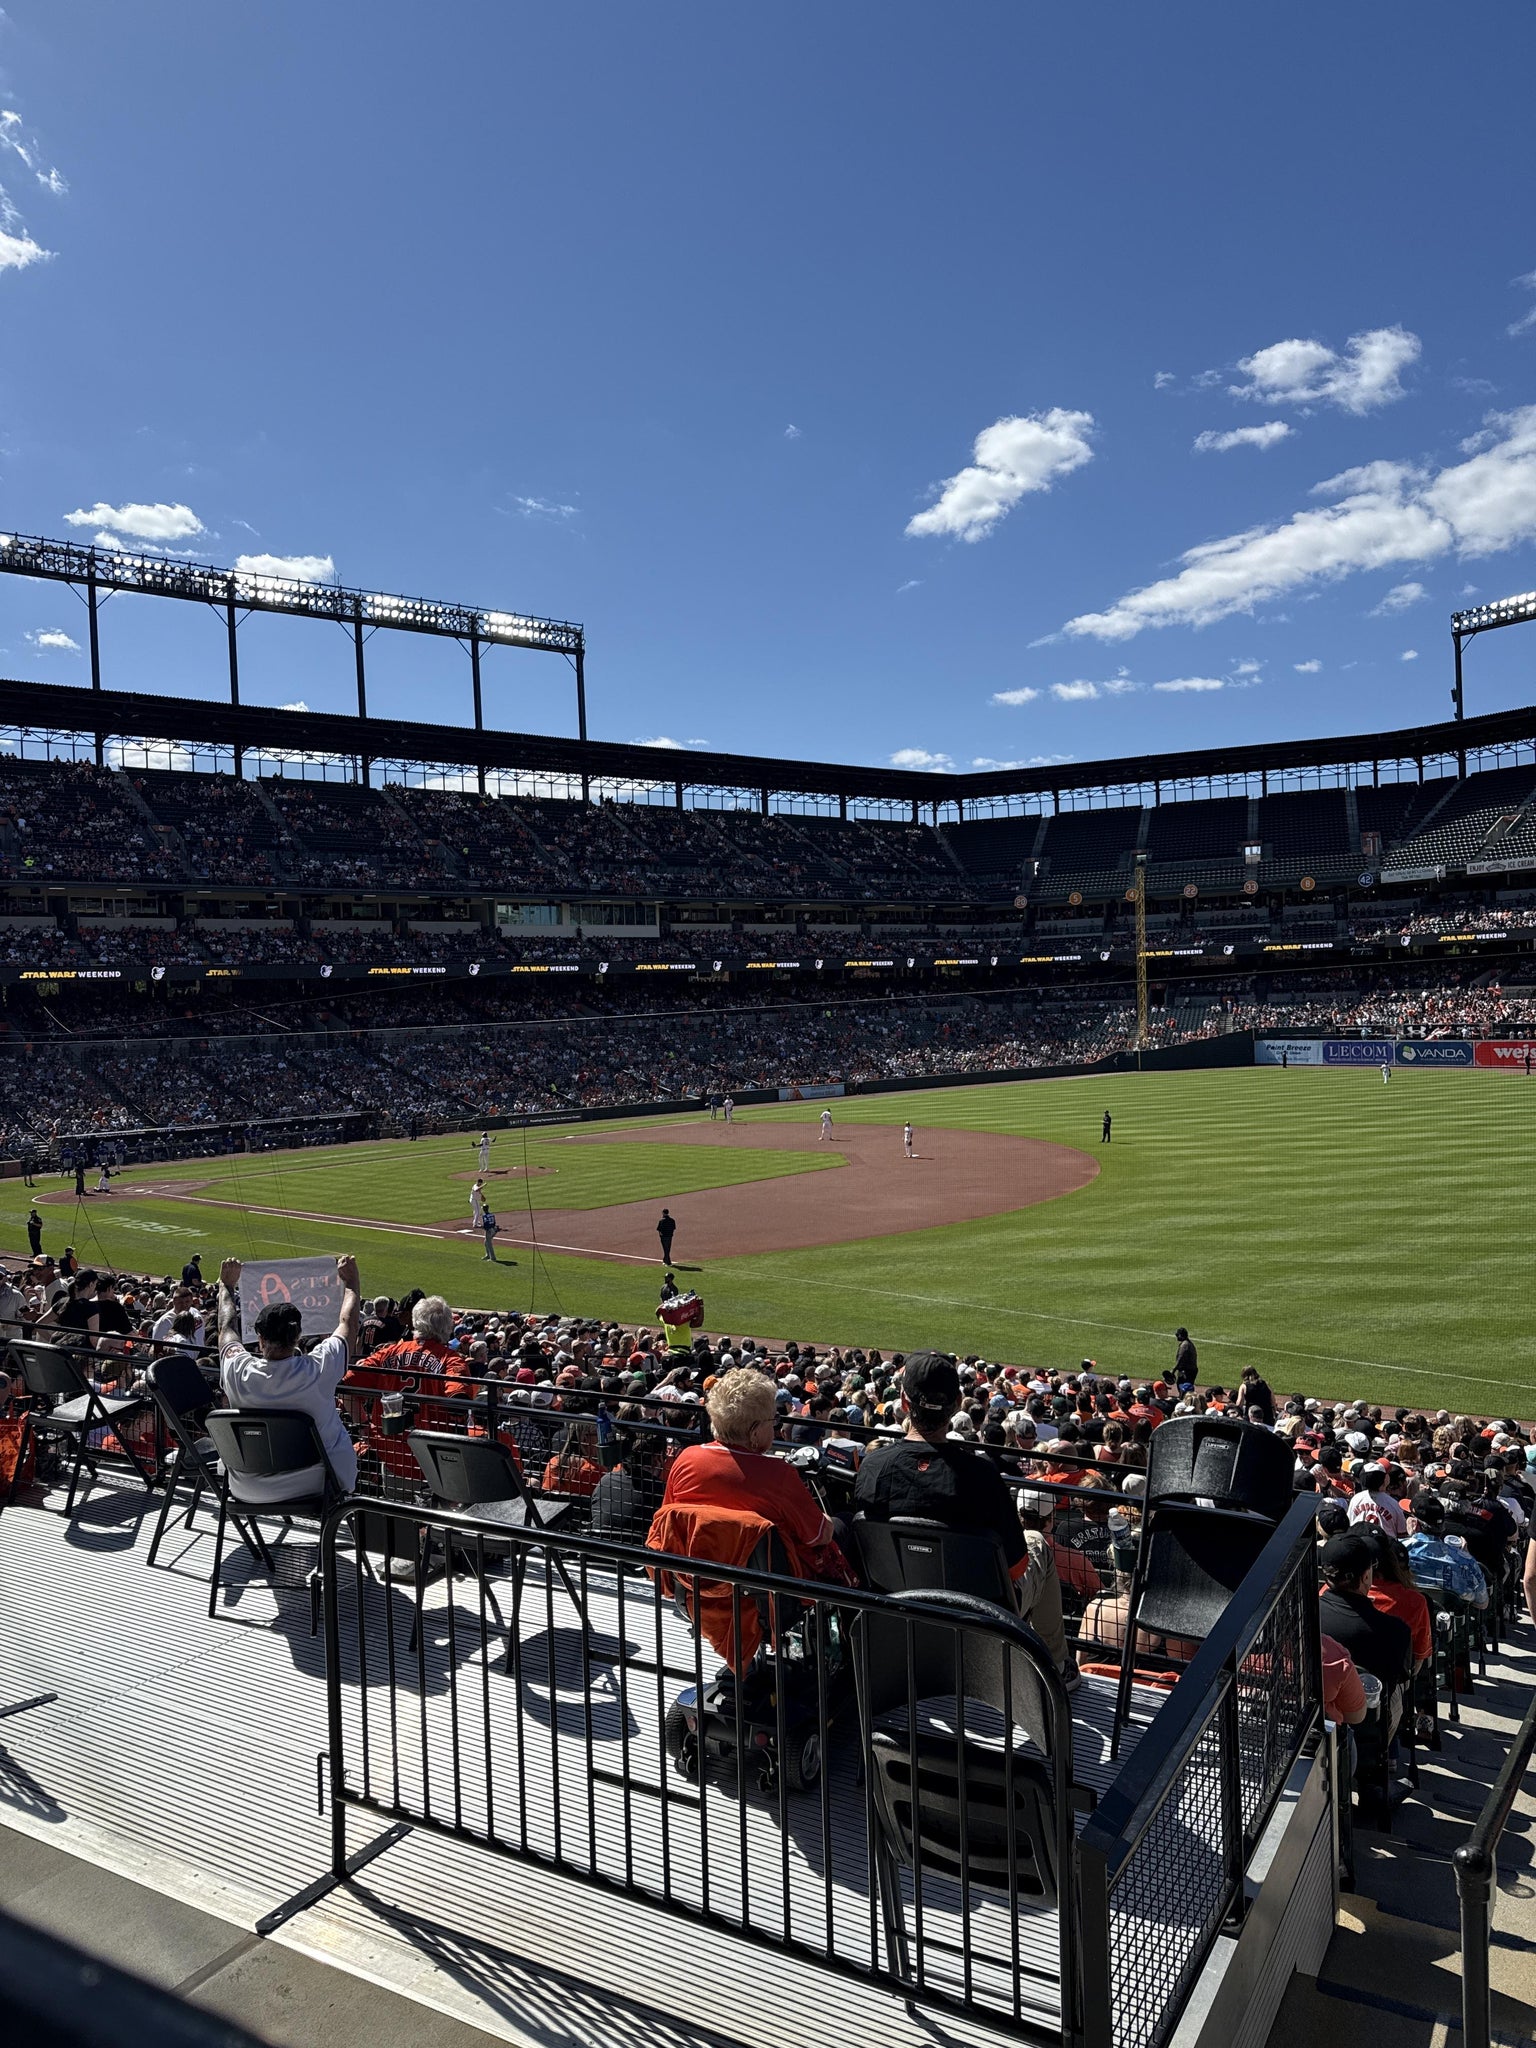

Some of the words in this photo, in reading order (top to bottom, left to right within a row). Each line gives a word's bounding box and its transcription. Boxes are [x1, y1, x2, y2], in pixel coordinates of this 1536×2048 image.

[1469, 864, 1485, 872] ENJOY
[1507, 861, 1516, 869] ICE
[1360, 876, 1372, 885] 42
[1185, 887, 1197, 895] 22
[1245, 883, 1257, 892] 33
[19, 971, 48, 979] STAR
[1328, 1045, 1388, 1057] LECOM
[1417, 1048, 1466, 1058] VANDA
